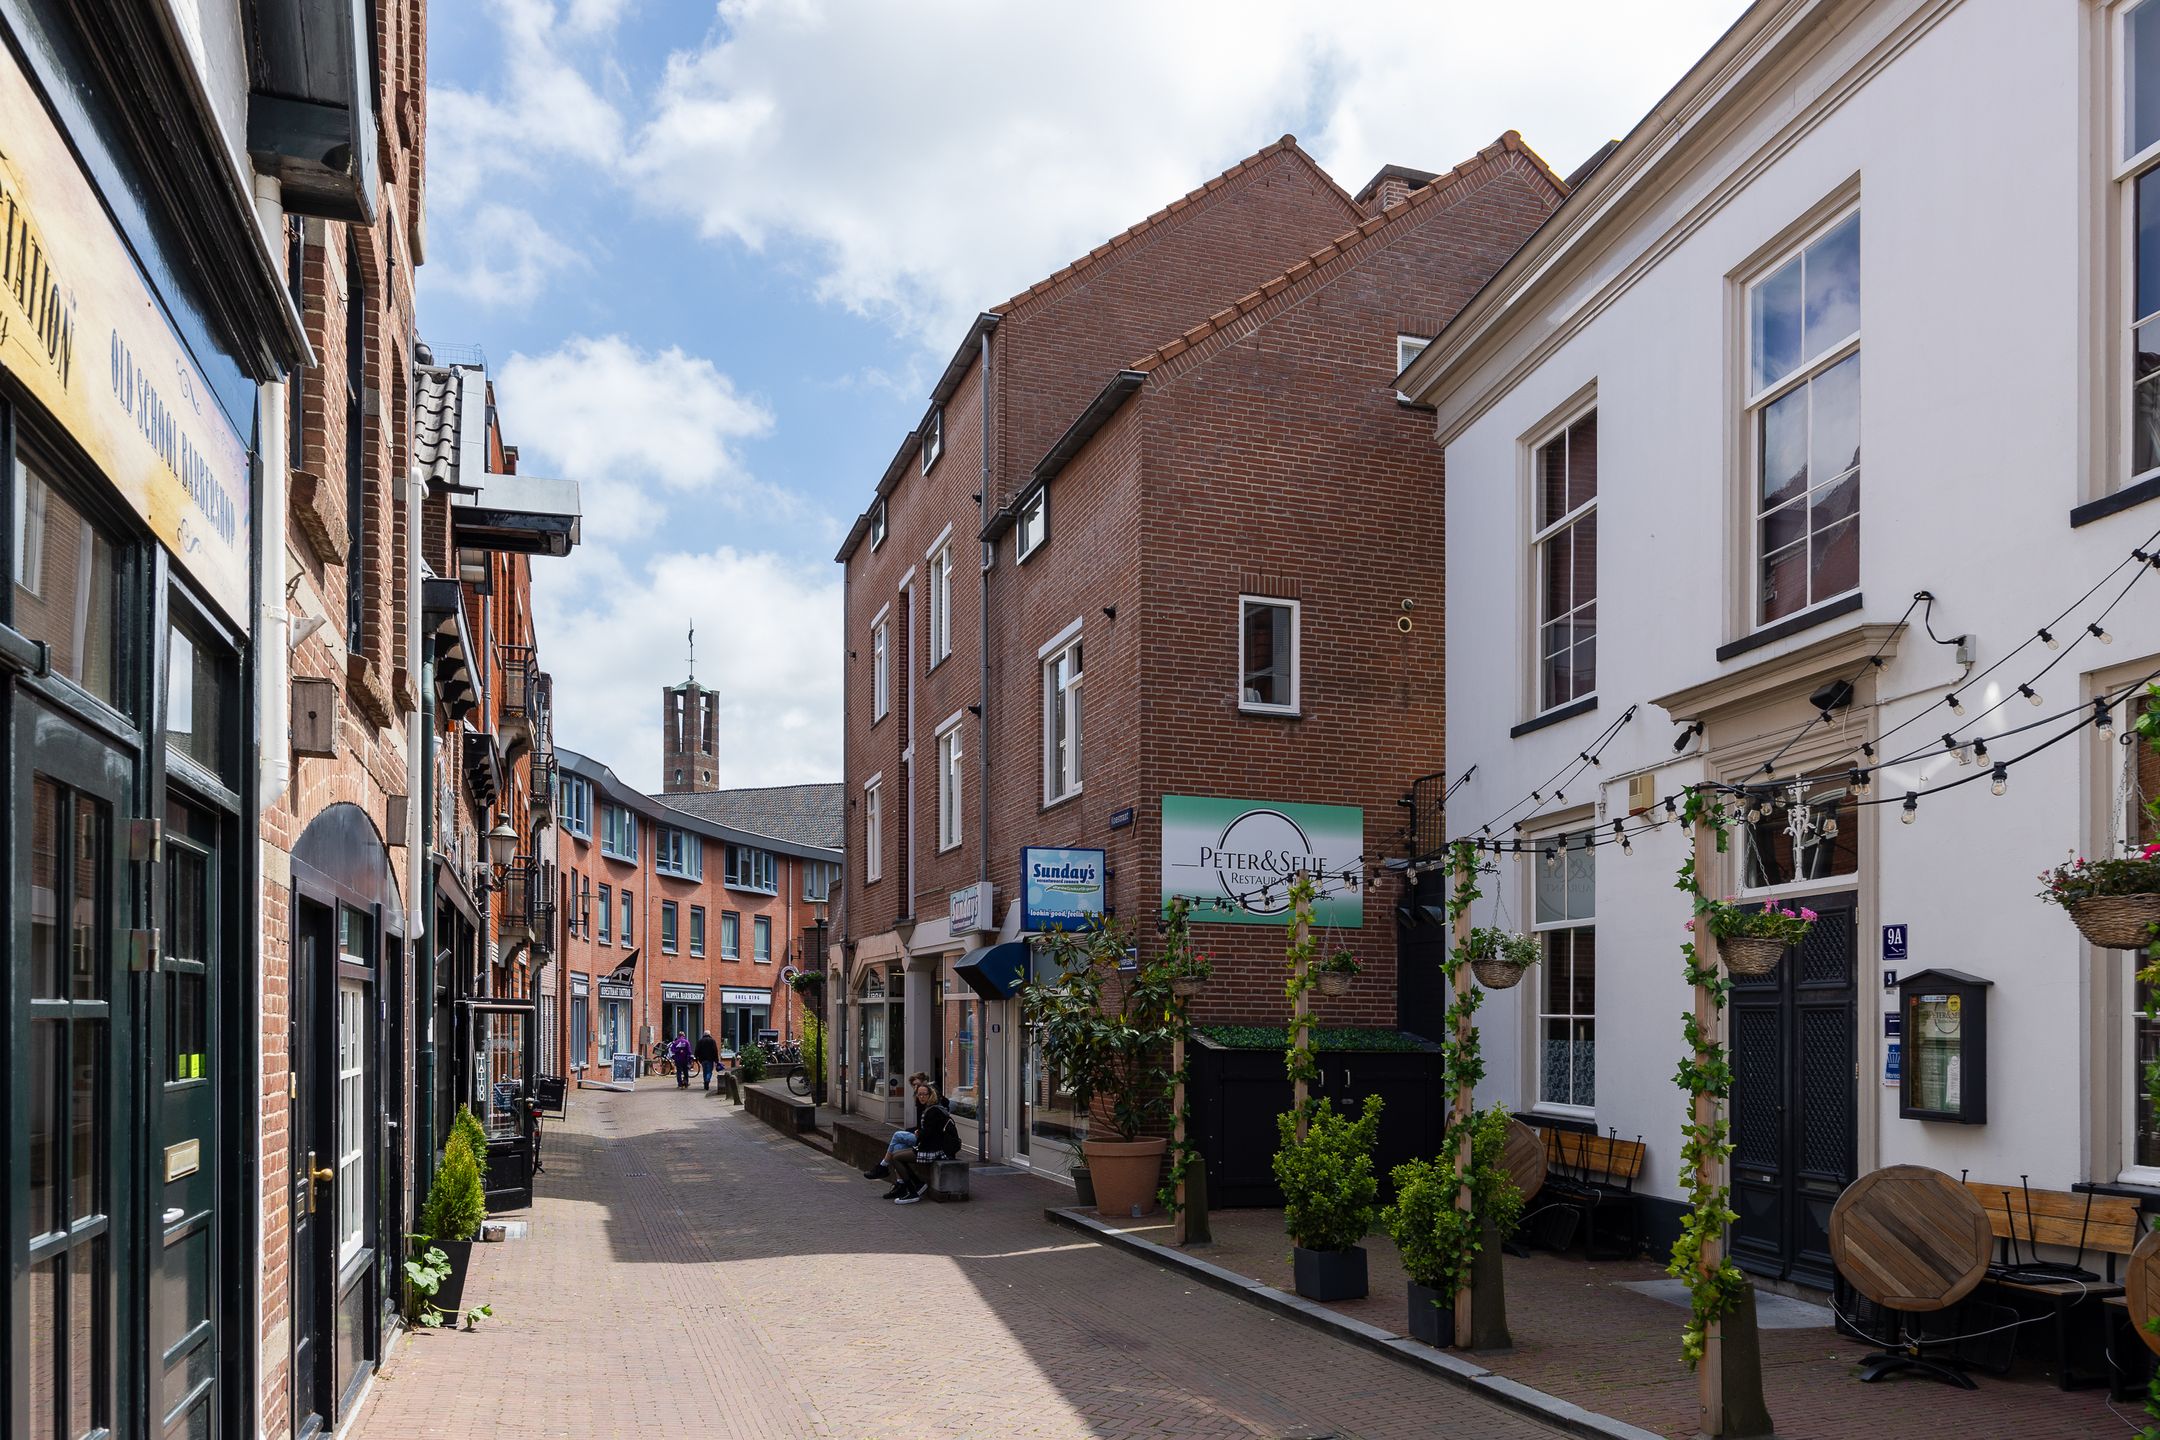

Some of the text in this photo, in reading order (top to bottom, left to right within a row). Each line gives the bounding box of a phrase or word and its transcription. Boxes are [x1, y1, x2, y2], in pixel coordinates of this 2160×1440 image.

[111, 327, 237, 550] OLD SCHOOL BARBERSHOP
[1033, 863, 1095, 884] Sunday's
[1887, 928, 1903, 945] 9A
[1887, 972, 1893, 985] 9
[477, 1056, 486, 1101] TATTOO
